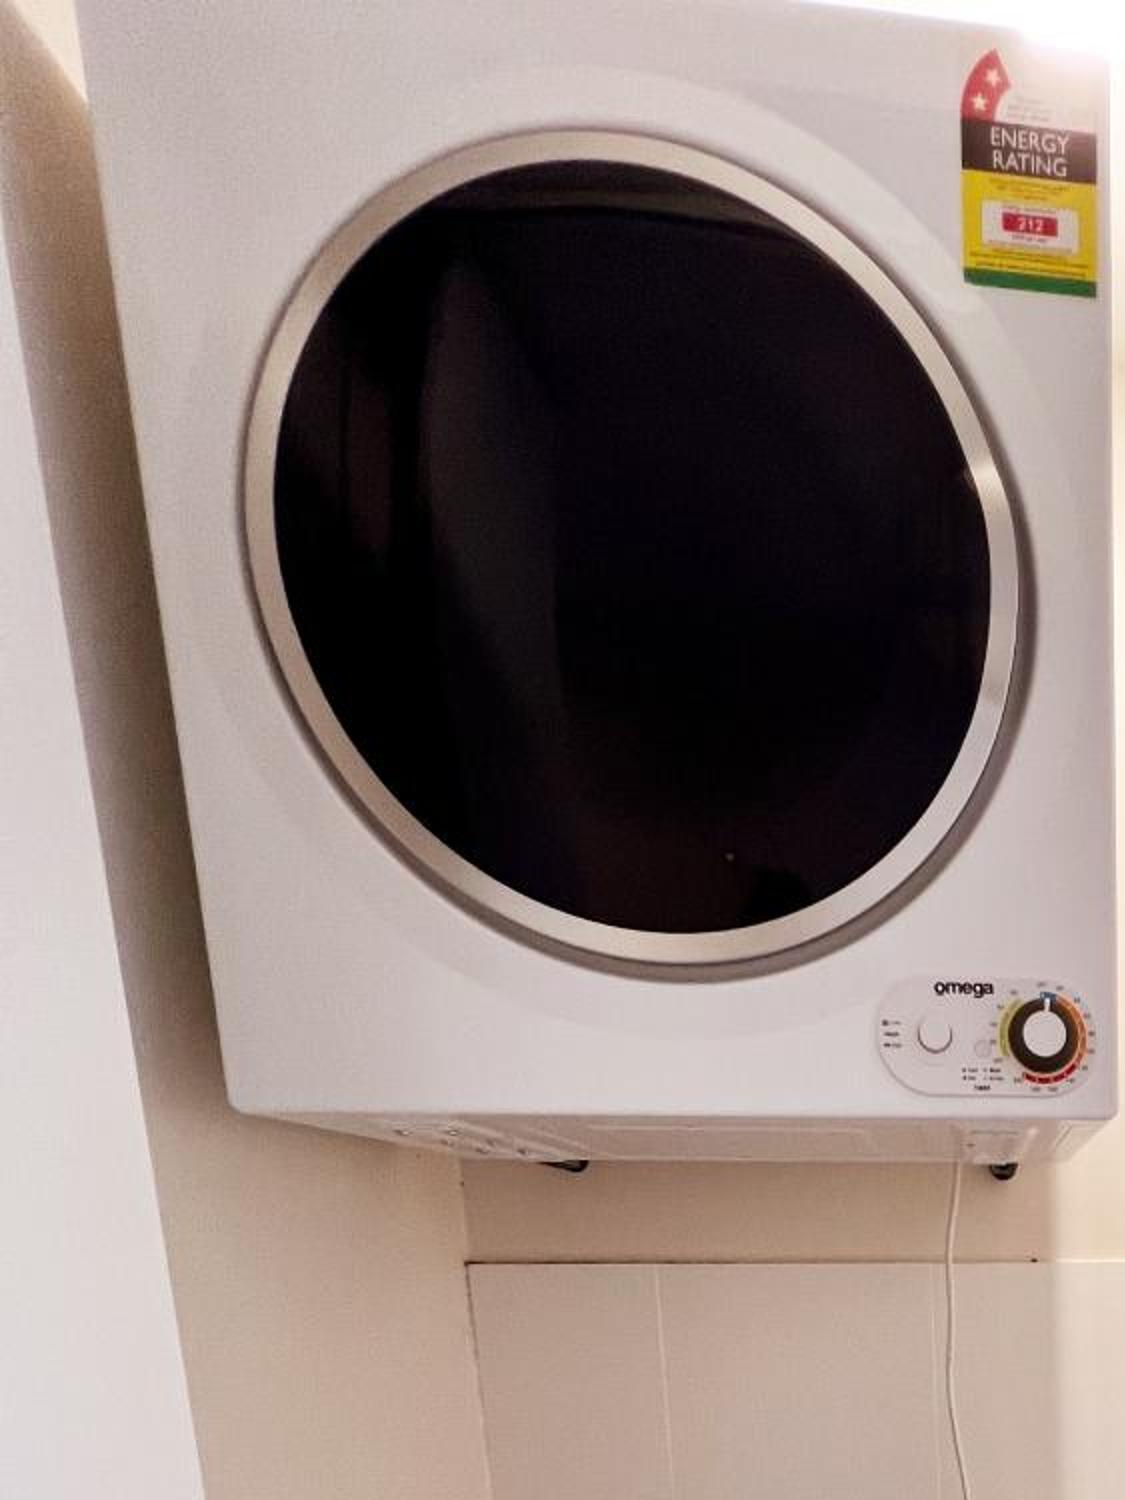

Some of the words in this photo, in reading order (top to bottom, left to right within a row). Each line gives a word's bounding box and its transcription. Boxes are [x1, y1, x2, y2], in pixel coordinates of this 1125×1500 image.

[990, 127, 1070, 155] ENERGY
[992, 151, 1068, 177] RATING
[934, 981, 994, 998] omega
